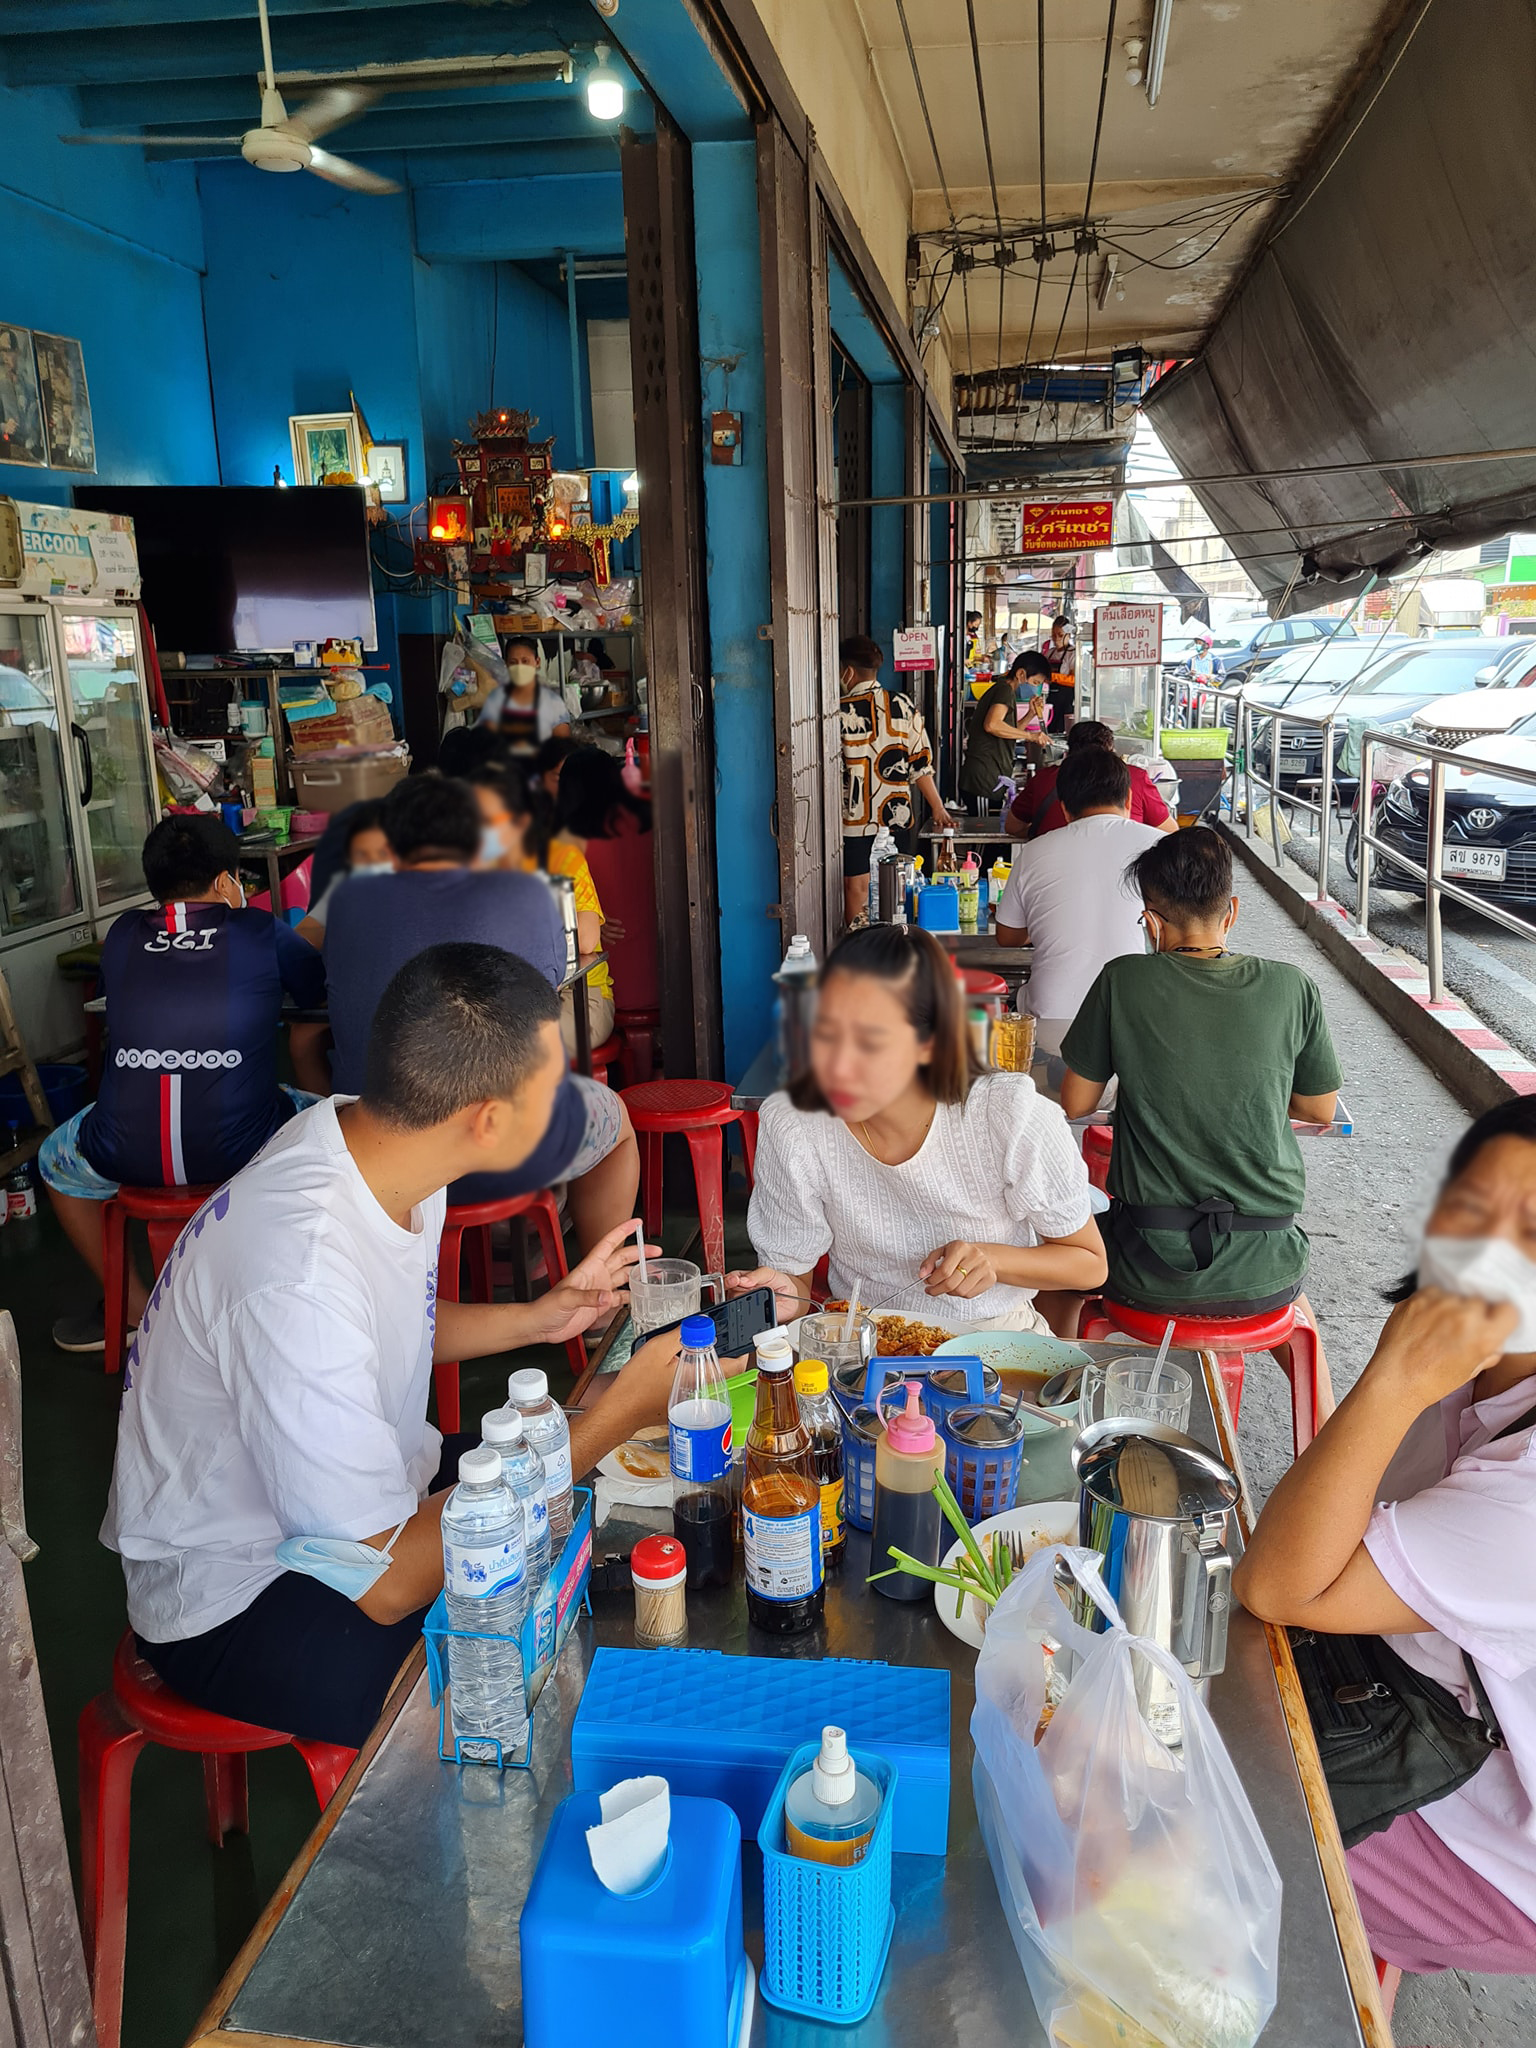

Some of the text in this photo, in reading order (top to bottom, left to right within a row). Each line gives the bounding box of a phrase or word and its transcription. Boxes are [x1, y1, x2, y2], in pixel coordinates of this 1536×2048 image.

[1102, 606, 1156, 623] ต้มเลือดหมู
[900, 632, 928, 642] OPEN
[1108, 626, 1150, 641] ข้าวเปล่า
[1472, 852, 1501, 867] 9879
[144, 927, 218, 952] SGI
[115, 1048, 243, 1070] ooredoo
